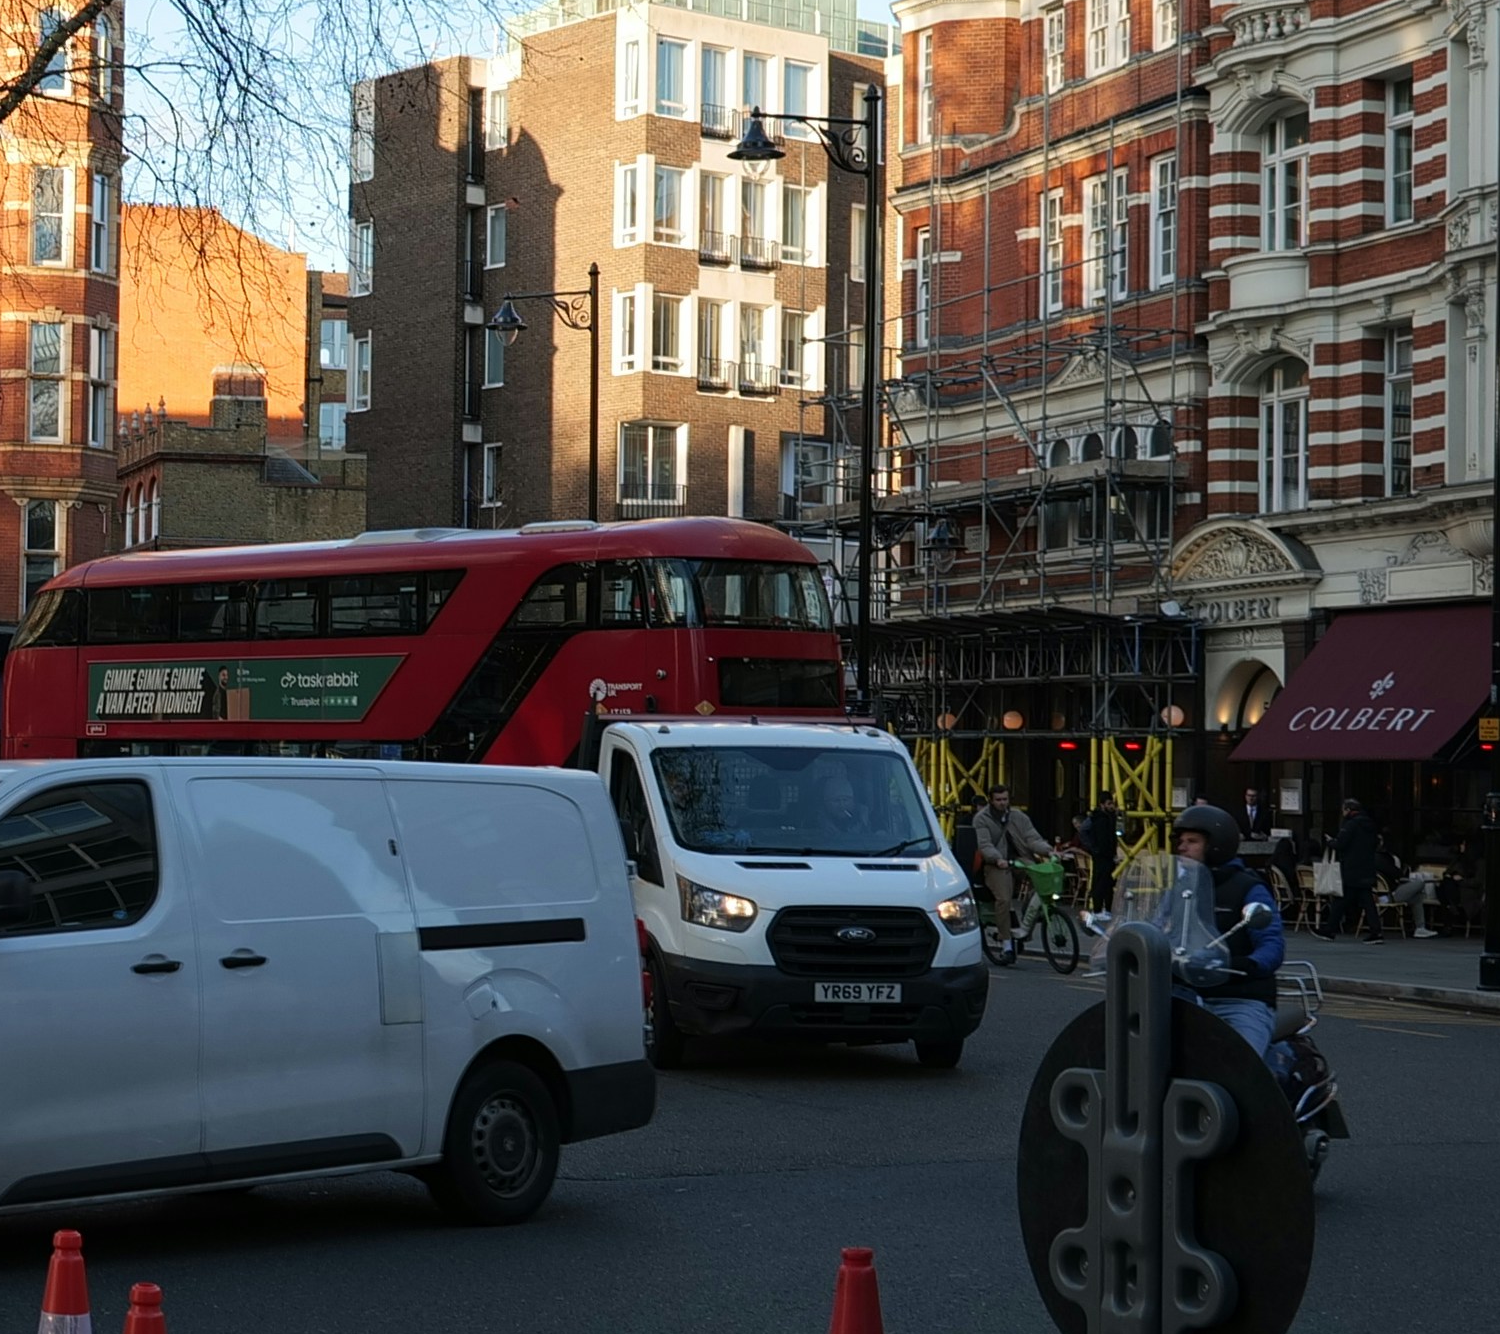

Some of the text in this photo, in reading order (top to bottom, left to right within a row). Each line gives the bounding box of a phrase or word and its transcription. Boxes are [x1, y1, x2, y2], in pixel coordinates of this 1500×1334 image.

[1193, 597, 1280, 624] COLBERT
[103, 667, 205, 691] GIMME GIMME GIMME
[298, 671, 359, 688] taskrabbit
[607, 683, 643, 691] TRANSPORT
[96, 691, 205, 714] A VAN AFTER MIDNIGHT
[290, 697, 321, 707] Trustpilot
[1288, 706, 1435, 732] COLBERT
[822, 985, 895, 1000] YR69 YFZ
